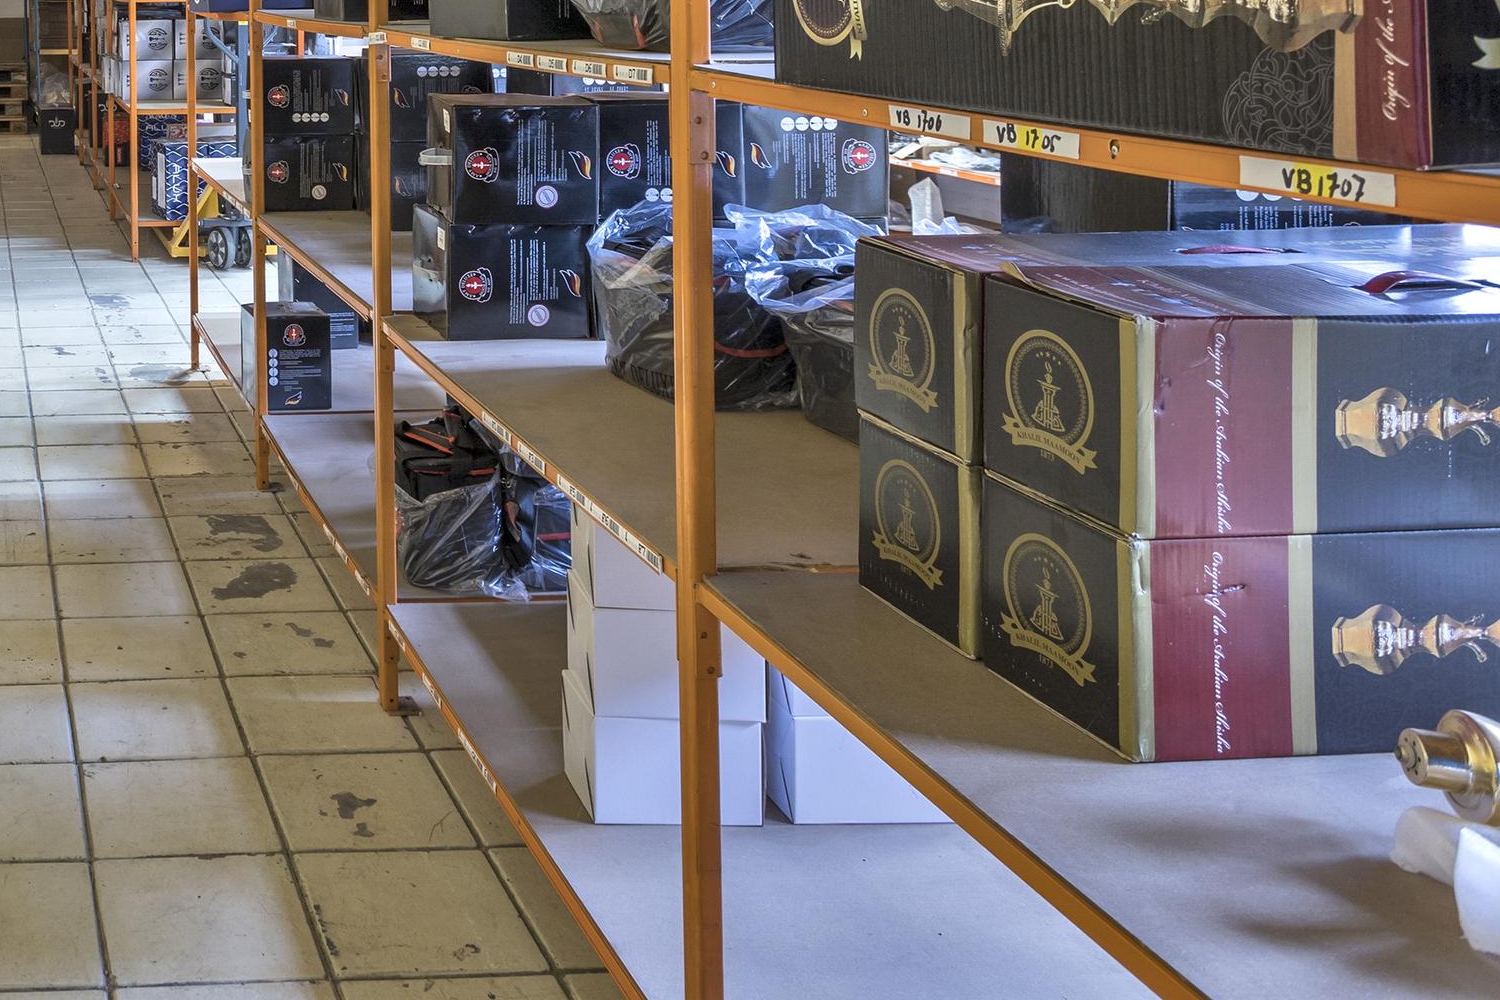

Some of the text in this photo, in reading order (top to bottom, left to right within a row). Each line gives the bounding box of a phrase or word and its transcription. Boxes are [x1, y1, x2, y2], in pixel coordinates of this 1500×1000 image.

[1375, 38, 1409, 66] of
[1376, 16, 1394, 42] the
[1383, 69, 1411, 121] Origin
[1206, 332, 1231, 534] Origin of the Arabian Shisha
[1204, 551, 1231, 754] Origin of the Arabian Shisha
